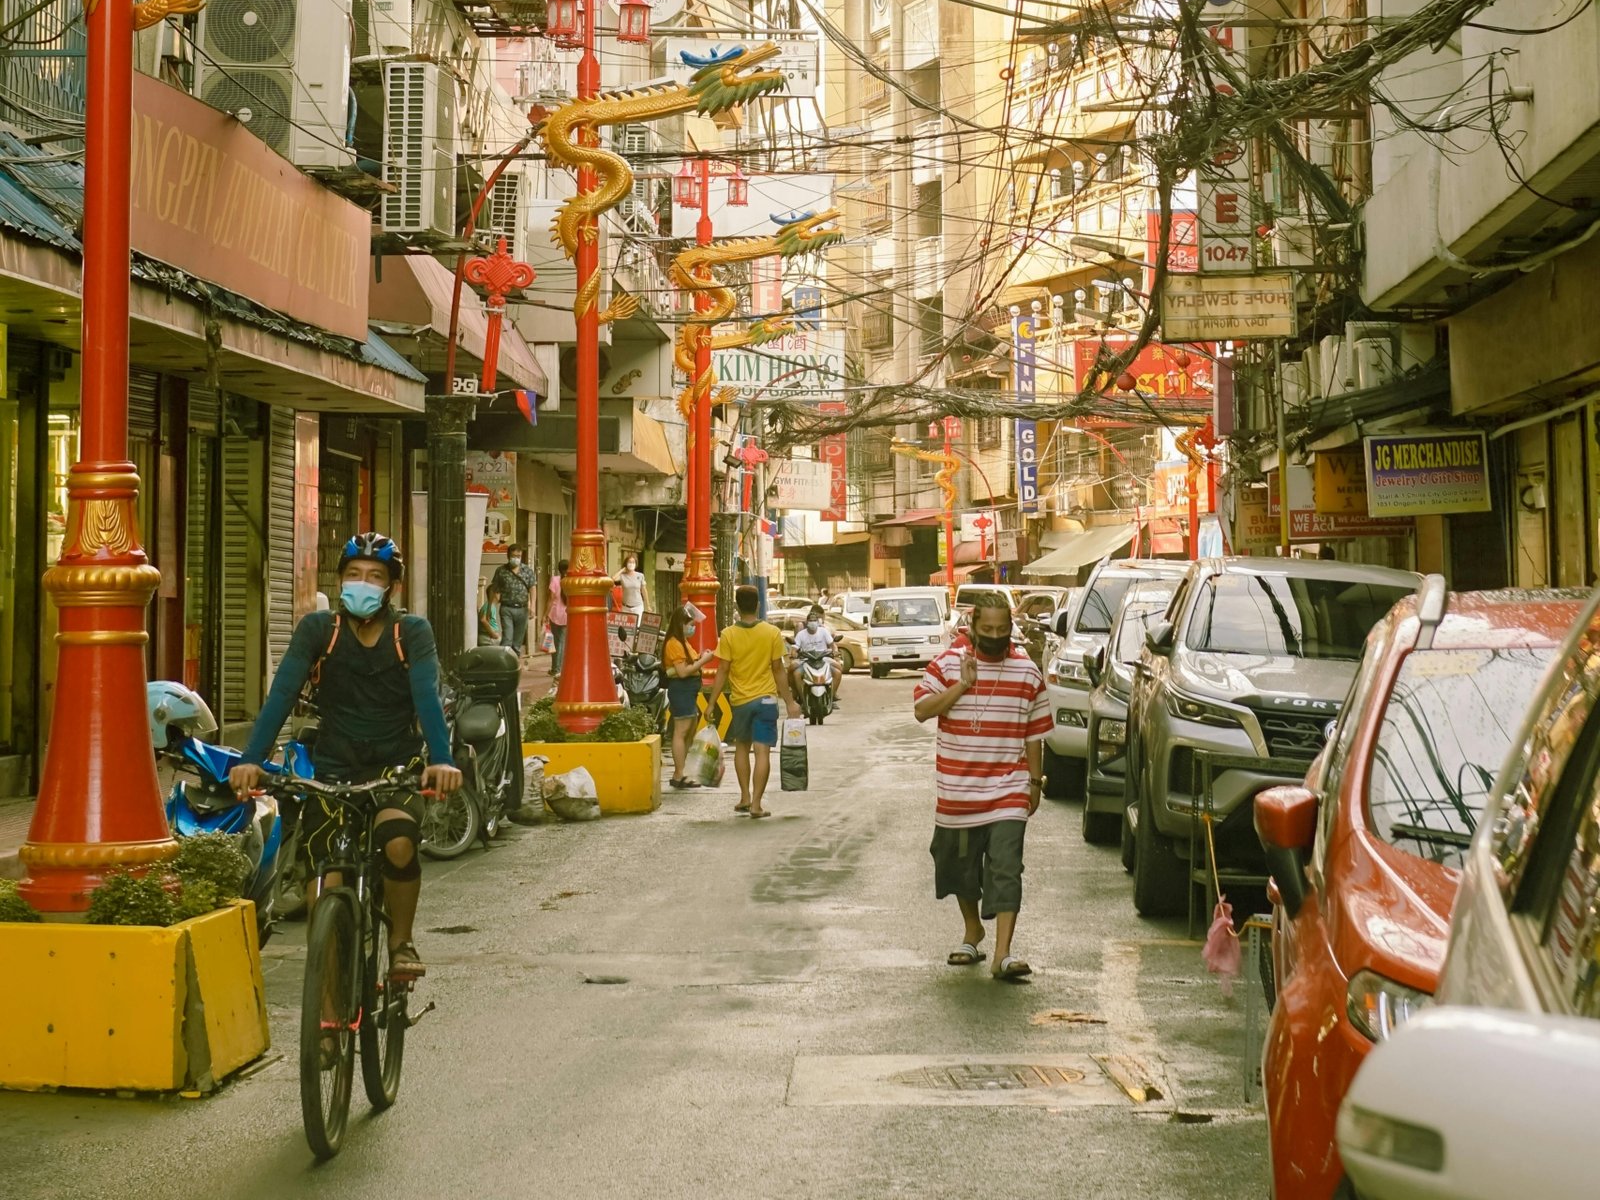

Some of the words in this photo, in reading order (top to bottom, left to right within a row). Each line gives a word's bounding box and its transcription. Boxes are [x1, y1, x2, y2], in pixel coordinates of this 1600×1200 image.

[296, 207, 360, 309] CENTER
[1205, 246, 1249, 262] 1047
[1020, 343, 1033, 402] FIN
[1021, 429, 1036, 501] GOLD
[1375, 444, 1391, 471] JG
[1392, 440, 1481, 470] MERCHANDISE
[1375, 473, 1416, 488] Jewelry
[1419, 472, 1427, 485] &
[1431, 471, 1452, 485] Gift
[1455, 470, 1481, 485] Shop
[1293, 522, 1310, 533] WE
[1294, 513, 1310, 523] WE
